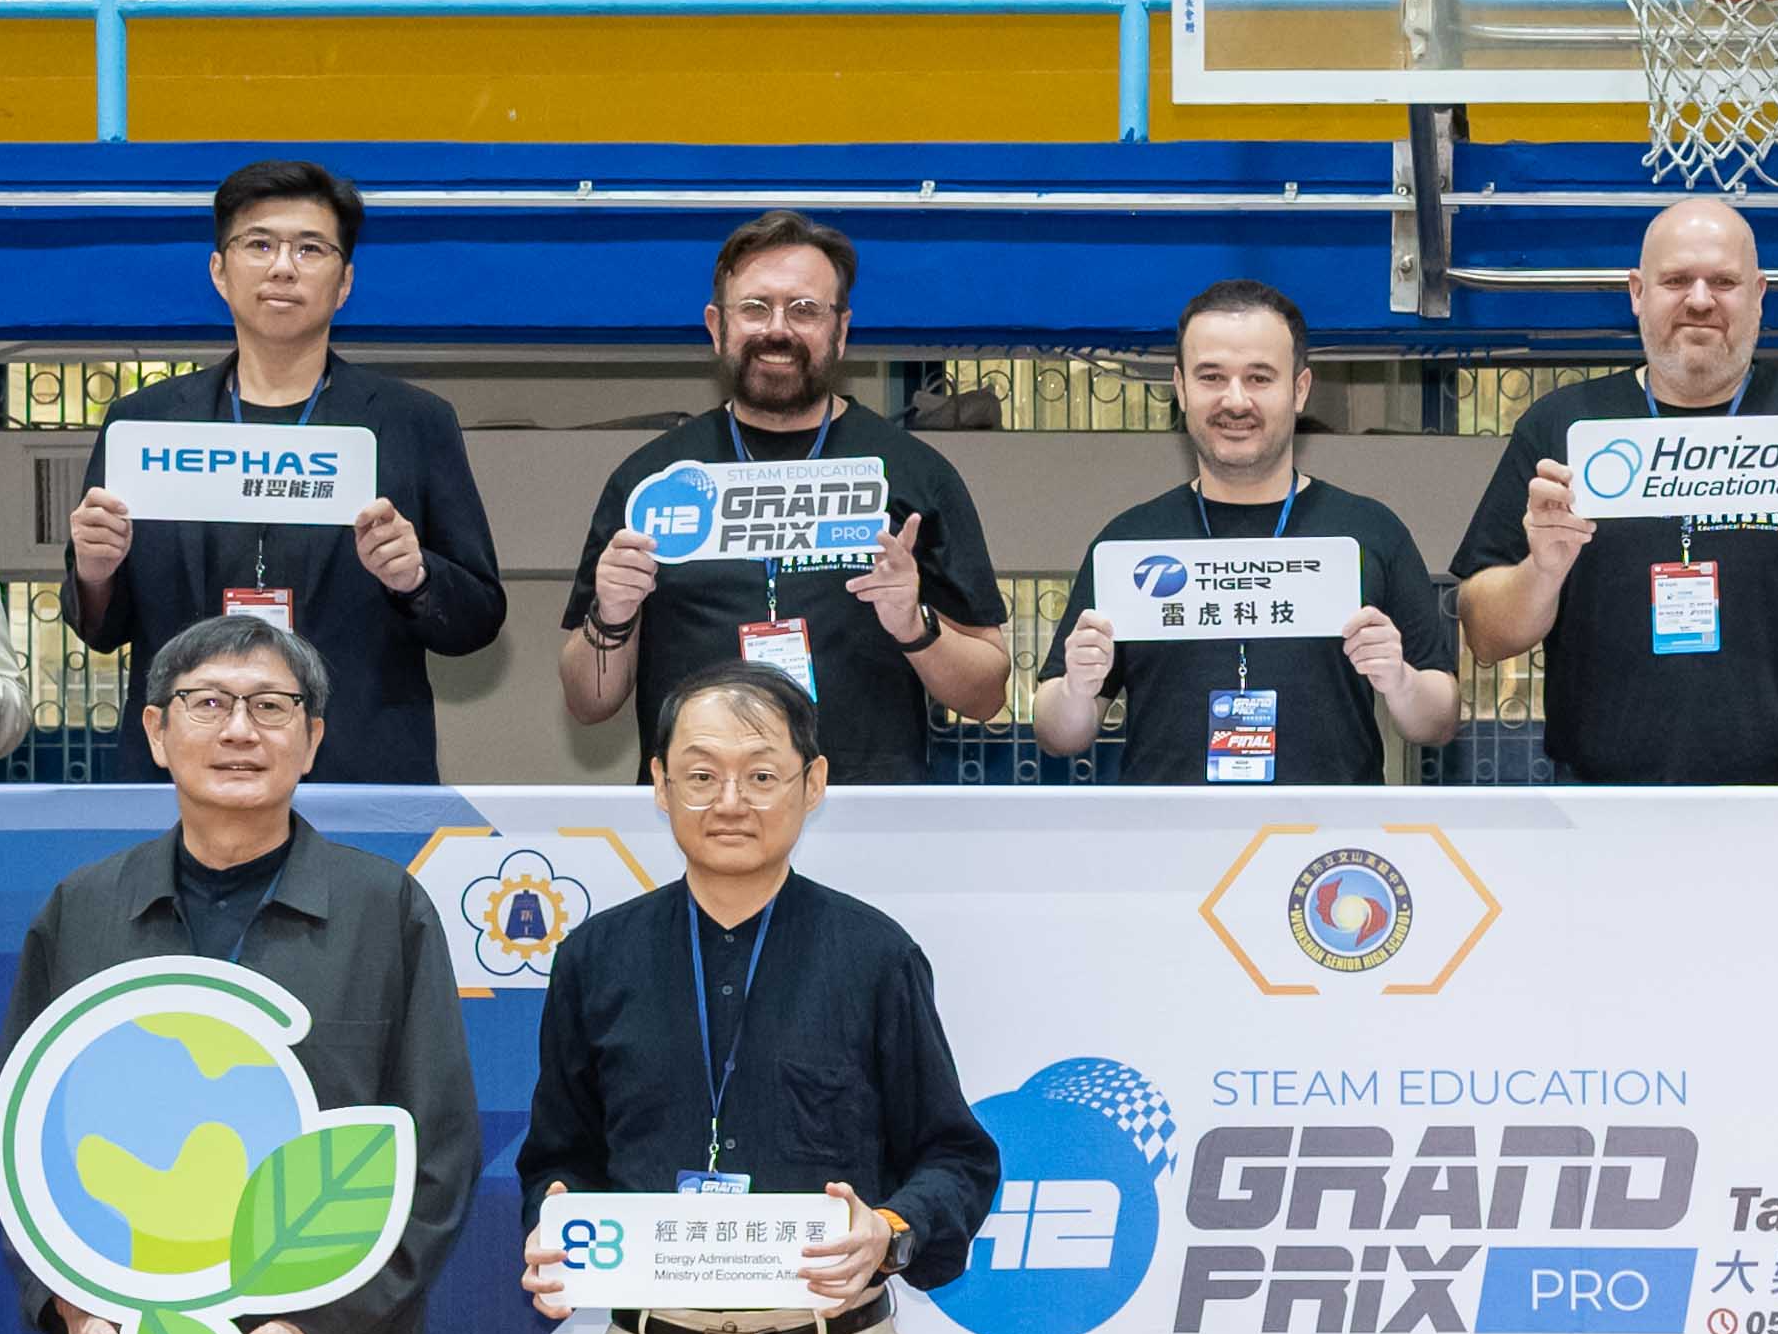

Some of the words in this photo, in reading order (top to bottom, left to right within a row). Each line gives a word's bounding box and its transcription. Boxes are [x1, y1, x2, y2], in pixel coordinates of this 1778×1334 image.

[142, 448, 338, 476] HEPHAS
[727, 466, 782, 483] STEAM
[786, 463, 880, 479] EDUCATION
[242, 478, 334, 500] 群翌能源
[720, 481, 883, 520] GRAND
[644, 505, 700, 535] H2
[718, 521, 817, 553] PRIX
[831, 526, 871, 542] PRO
[1195, 560, 1321, 574] THUNDER
[1195, 577, 1272, 591] TIGER
[1161, 602, 1296, 627] 雷虎科技
[1227, 735, 1271, 747] FINAL
[1324, 952, 1362, 971] SENIOR
[1363, 947, 1388, 969] HIGH
[1383, 910, 1410, 954] SCHOOL
[1212, 1071, 1378, 1107] STEAM
[1400, 1070, 1688, 1107] EDUCATION
[1184, 1125, 1700, 1231] GRAND
[655, 1220, 828, 1243] 經濟部能源署
[966, 1179, 1122, 1270] H2
[654, 1253, 695, 1266] Energy
[654, 1269, 702, 1282] Ministry
[703, 1269, 714, 1281] of
[715, 1270, 773, 1281] Economic
[1173, 1245, 1483, 1334] PRIX
[1531, 1269, 1650, 1311] PRO
